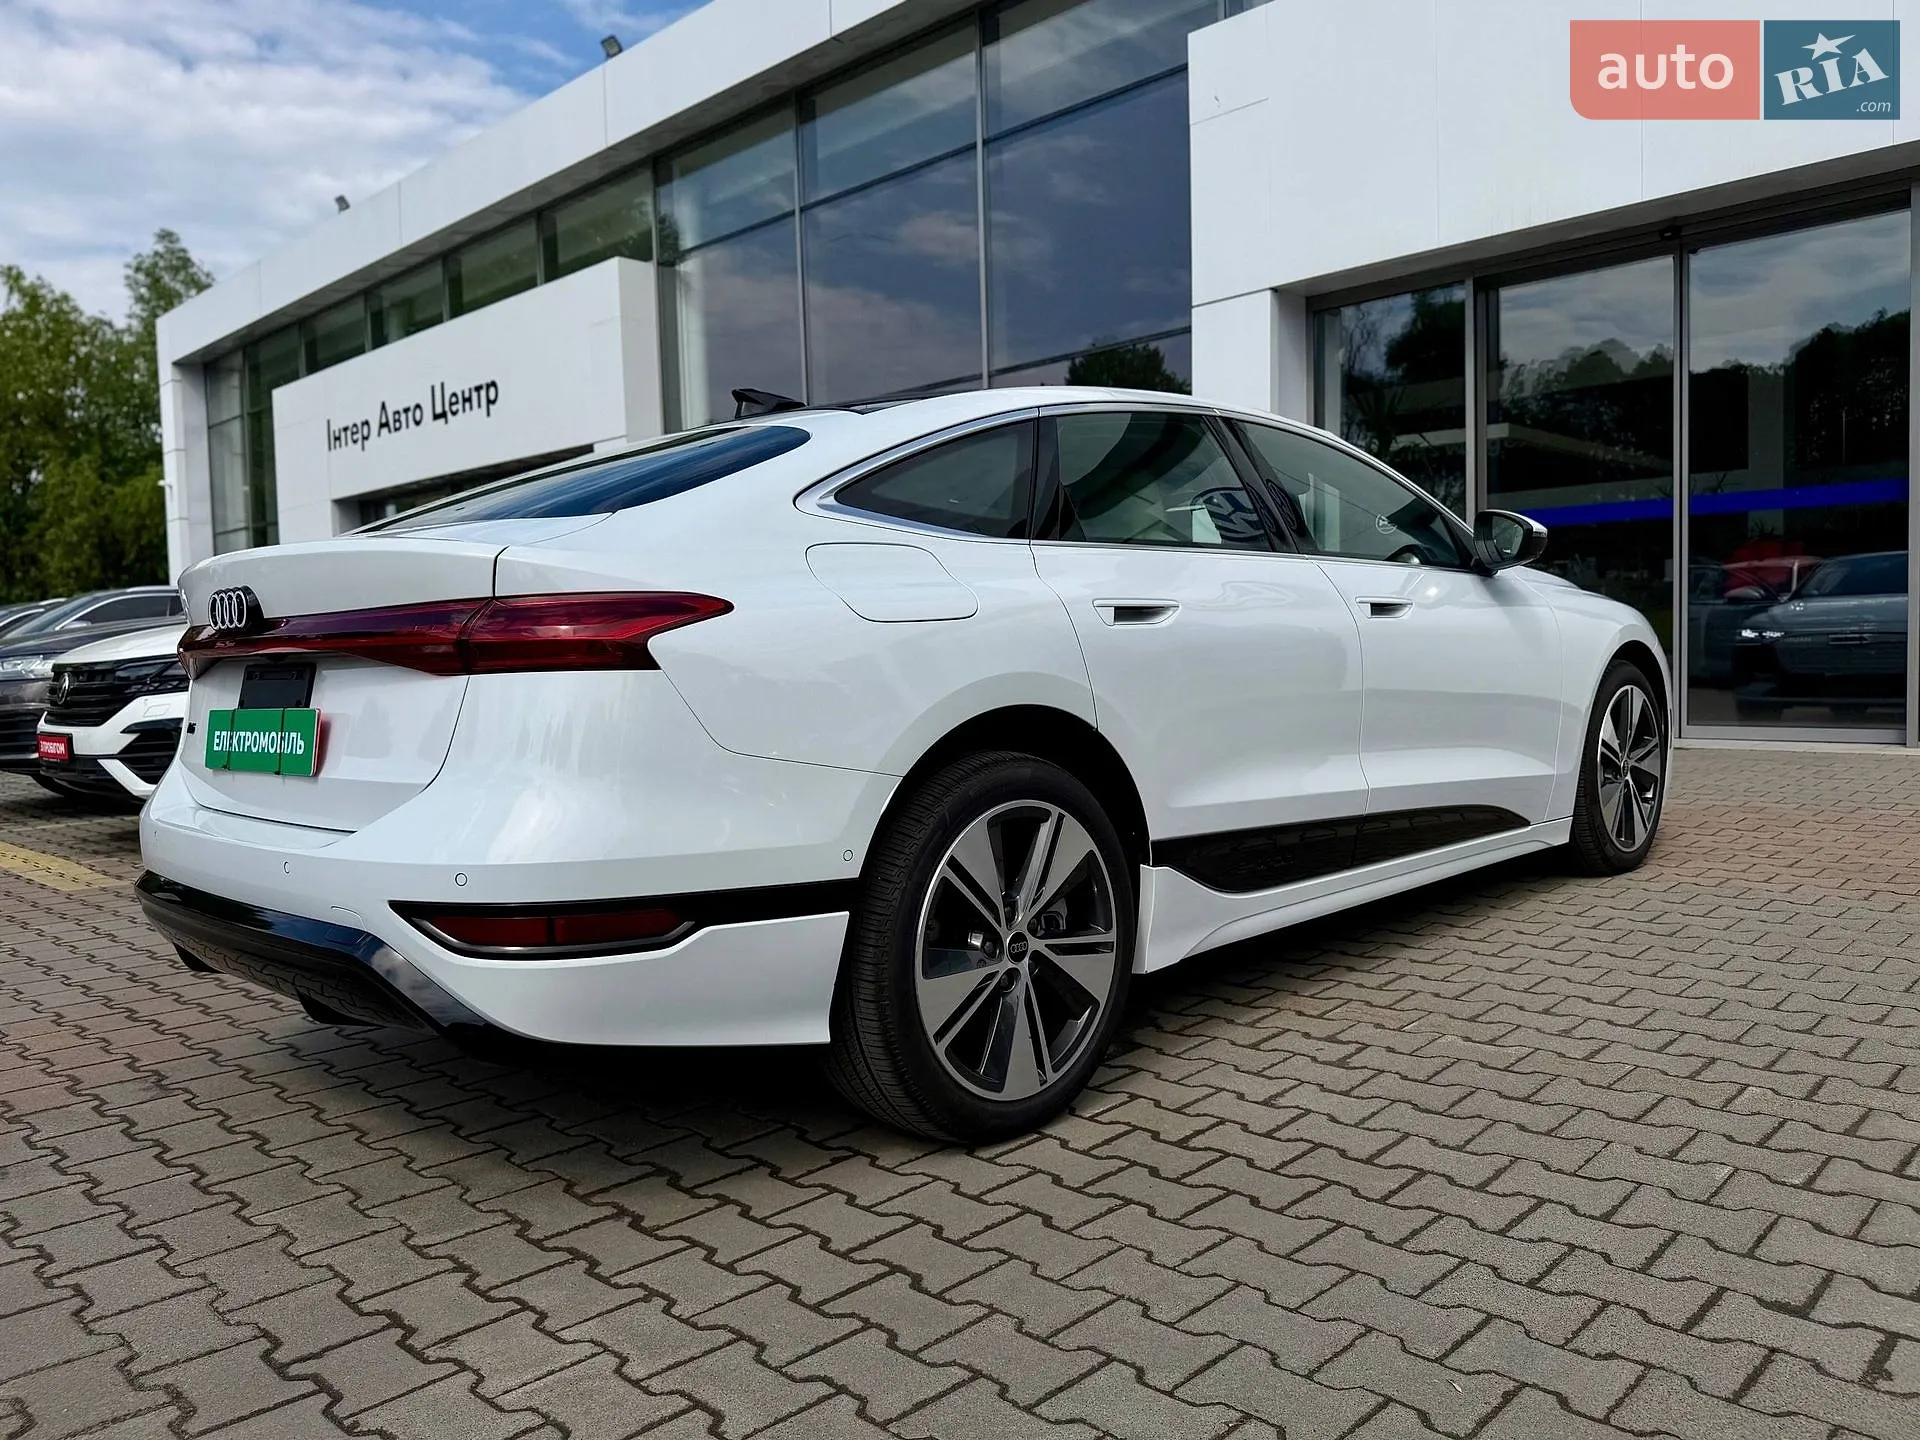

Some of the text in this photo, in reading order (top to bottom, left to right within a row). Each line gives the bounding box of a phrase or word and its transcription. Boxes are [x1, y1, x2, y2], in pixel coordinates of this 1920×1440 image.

[327, 380, 499, 451] Інтер Авто Центр
